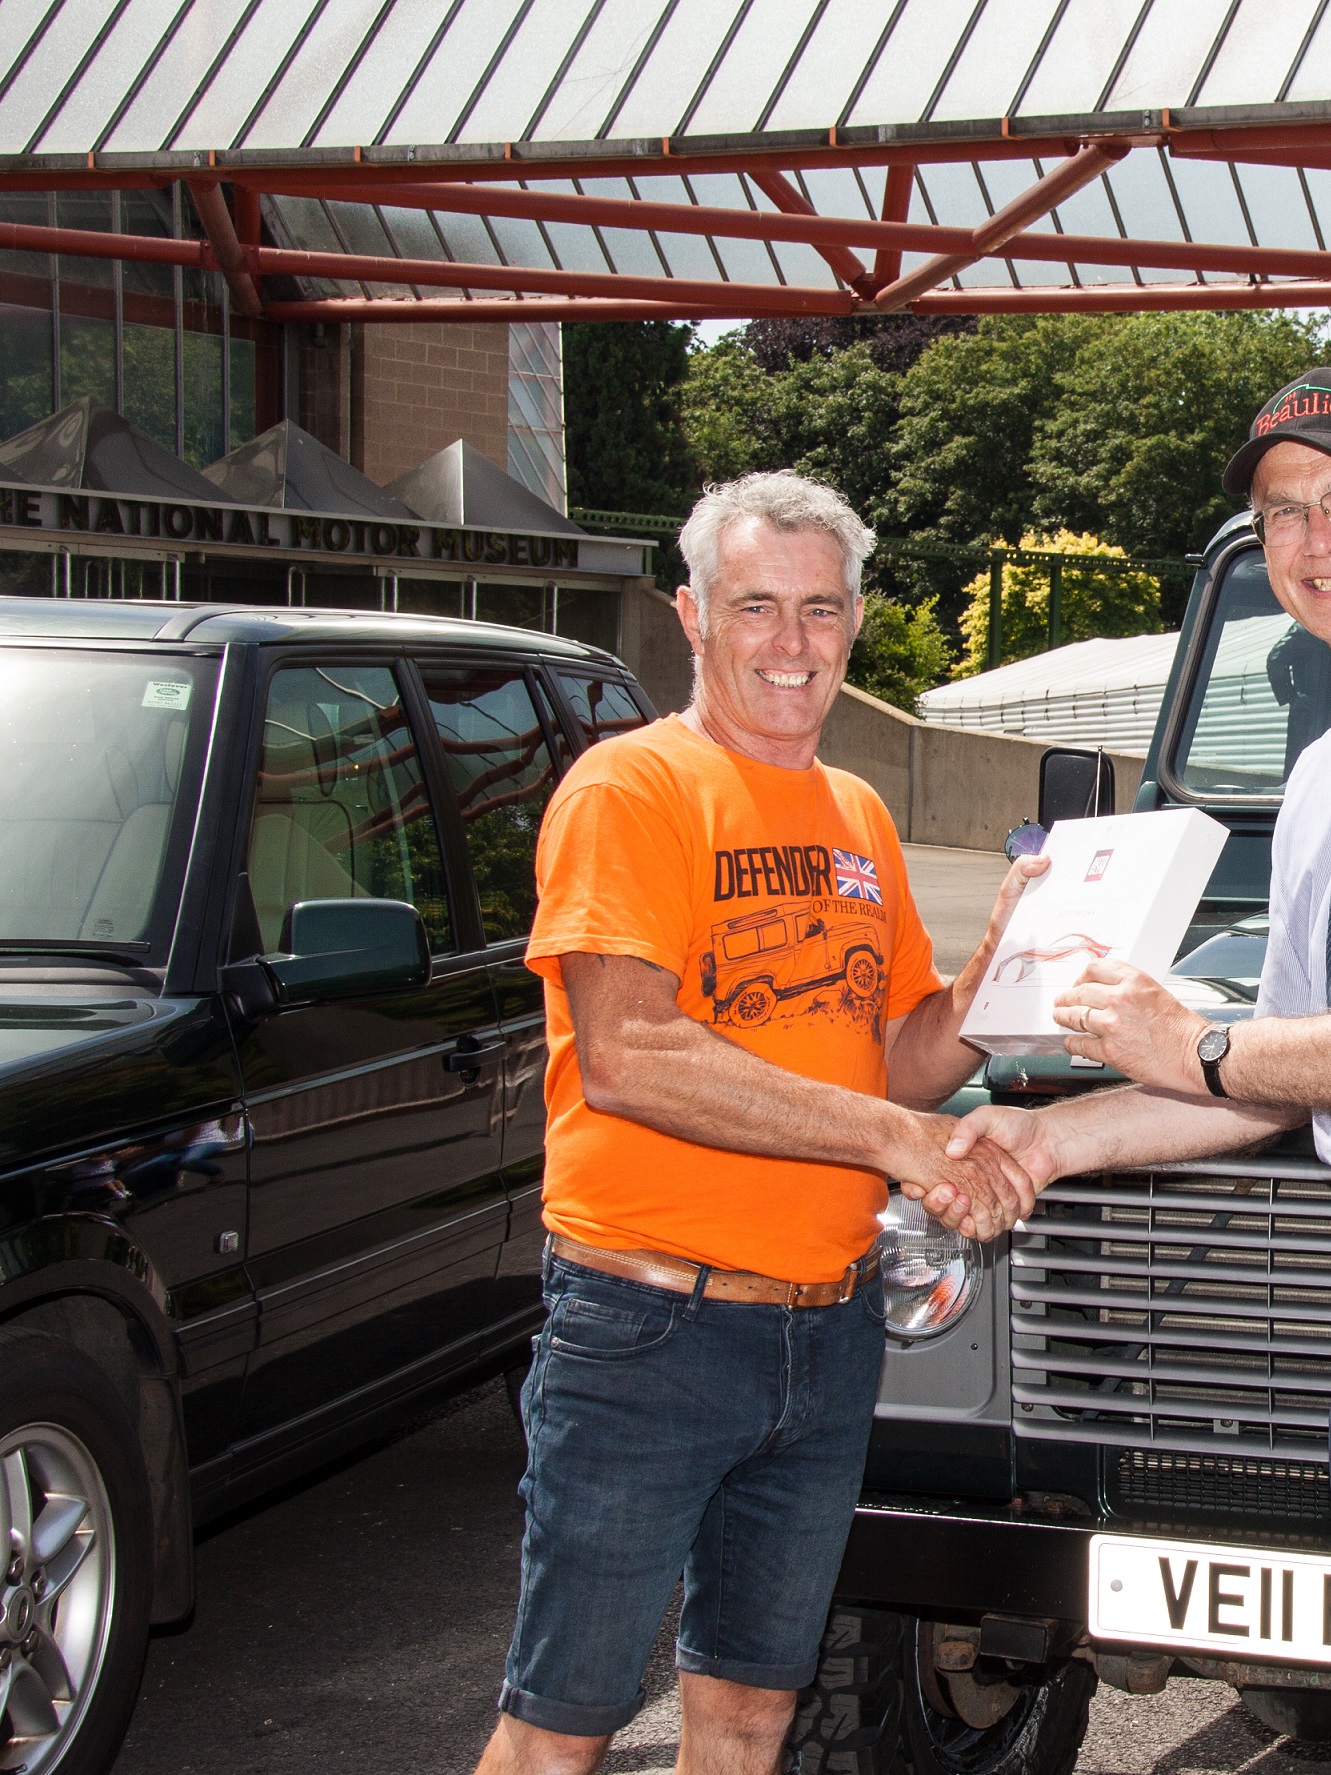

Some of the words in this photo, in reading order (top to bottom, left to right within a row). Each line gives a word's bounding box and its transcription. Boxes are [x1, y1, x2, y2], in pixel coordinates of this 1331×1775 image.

[58, 493, 280, 546] NATIONAL
[292, 516, 421, 557] MOTOR
[432, 526, 579, 568] MUSEUM
[714, 845, 833, 902] DEFENDER
[812, 899, 830, 914] OF
[832, 900, 858, 915] THE
[859, 902, 888, 924] REALM
